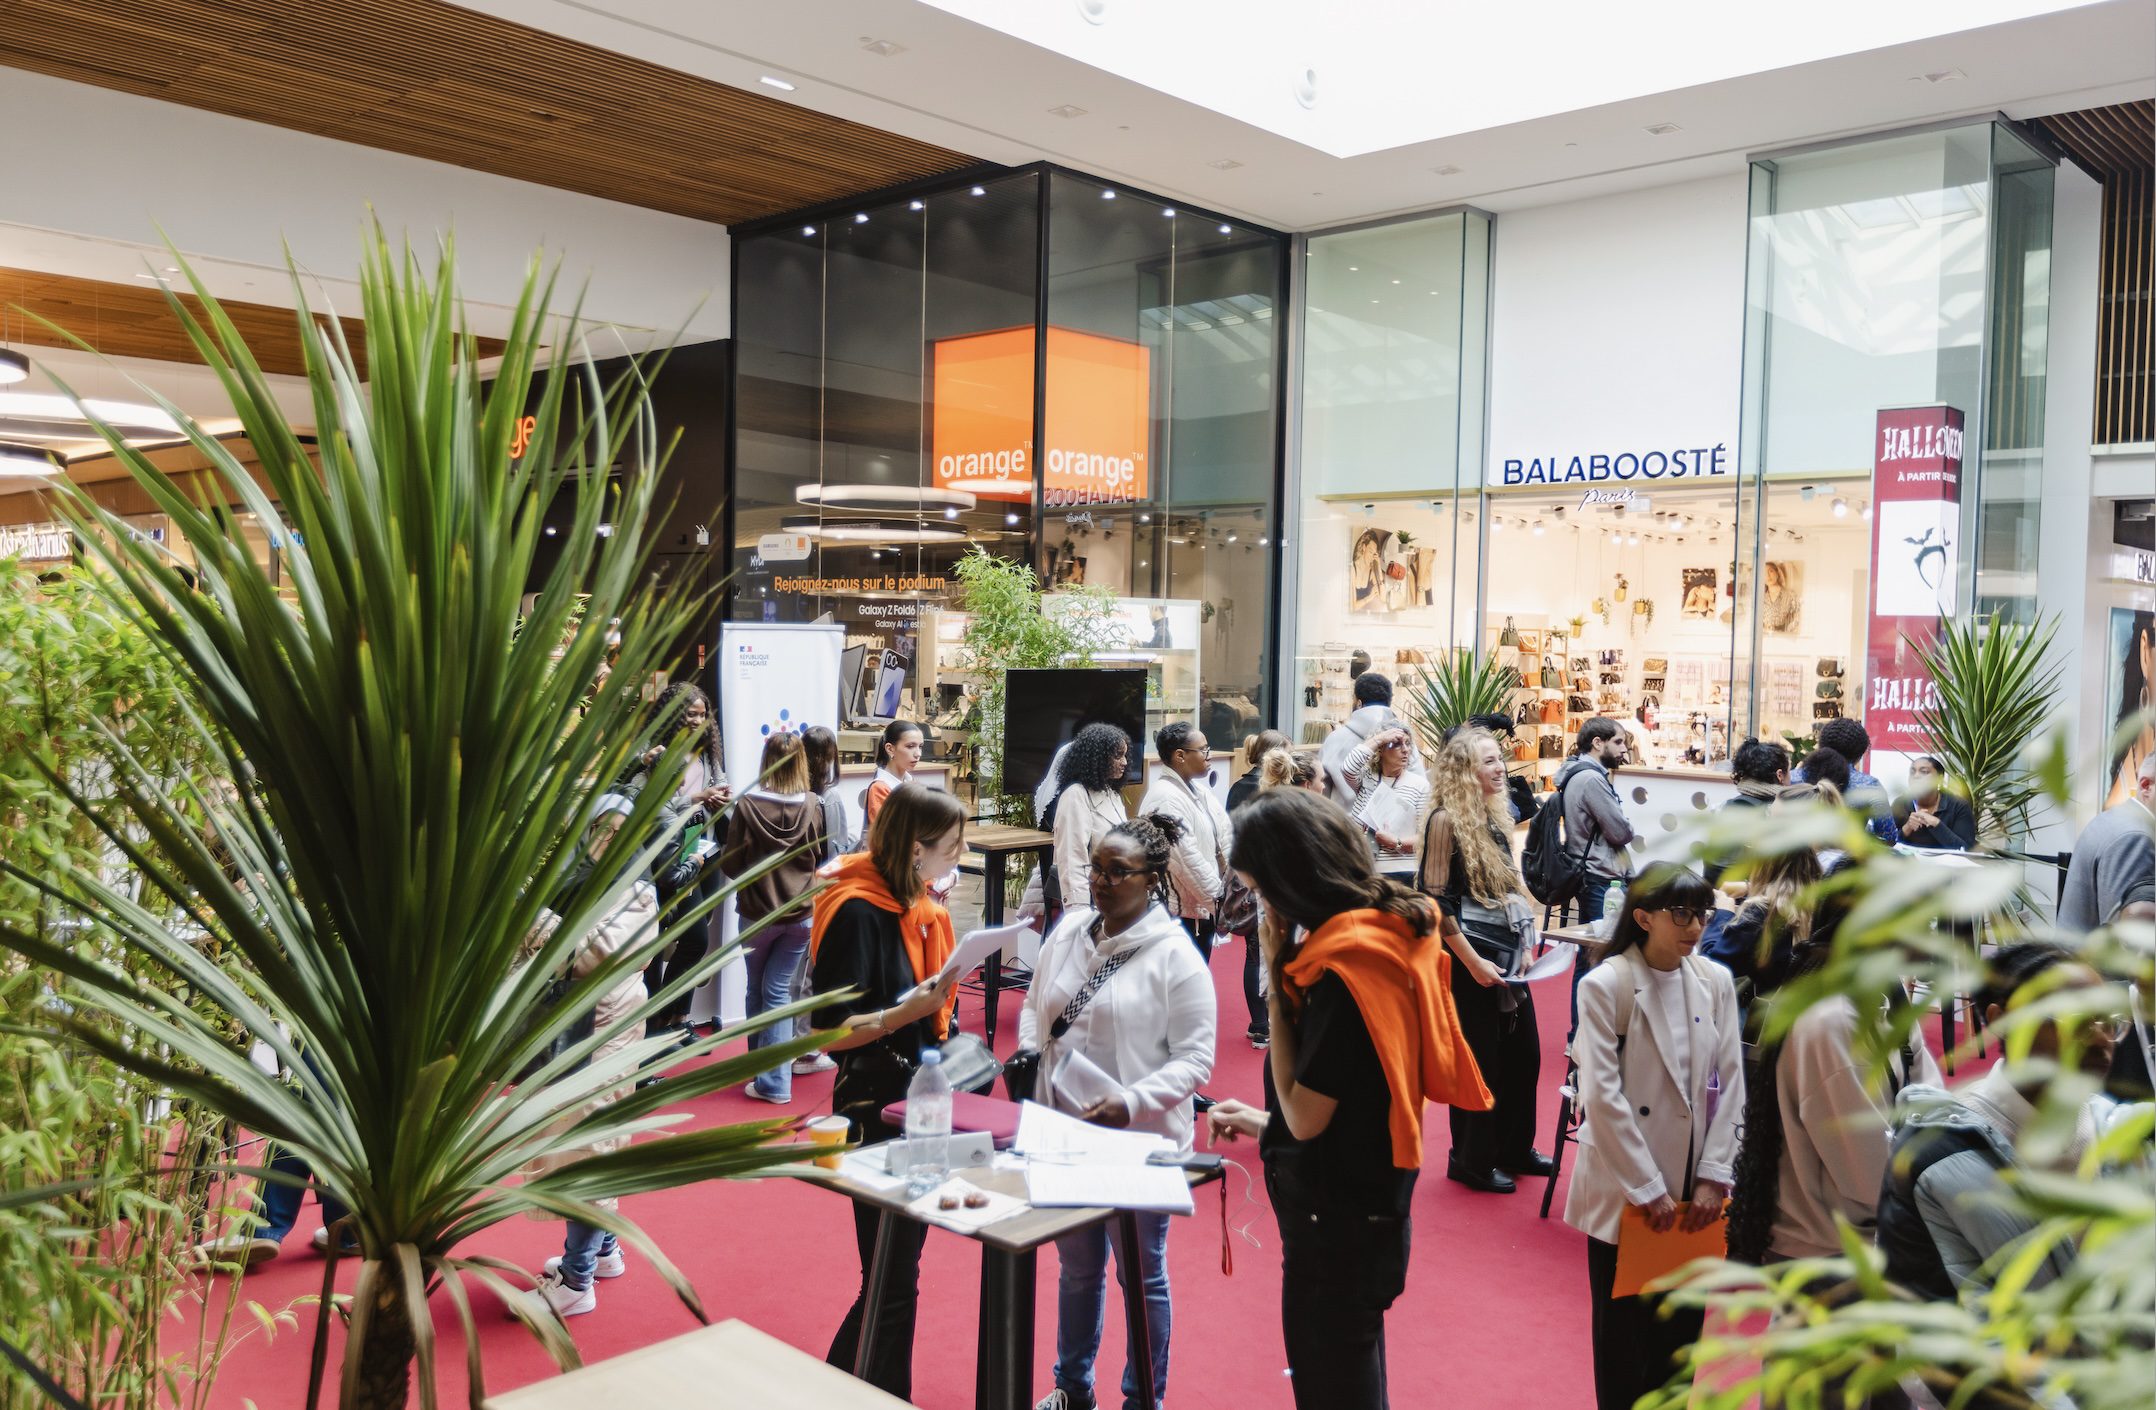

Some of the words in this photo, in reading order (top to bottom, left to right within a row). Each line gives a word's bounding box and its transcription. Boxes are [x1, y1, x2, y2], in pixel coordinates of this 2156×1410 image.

[939, 448, 1026, 481] orange
[1048, 448, 1135, 487] orange
[1503, 442, 1727, 485] BALABOOSTÉ
[1897, 471, 1905, 482] À
[1906, 471, 1941, 482] PARTIR
[1577, 486, 1636, 512] Paris
[773, 575, 860, 594] Rejoignez-nous
[863, 577, 882, 590] sur
[884, 574, 896, 590] le
[898, 573, 945, 592] podium
[858, 604, 887, 618] Galaxy
[887, 605, 893, 616] Z
[894, 604, 916, 616] Fold6
[875, 620, 896, 630] Galaxy
[1887, 721, 1895, 733] À
